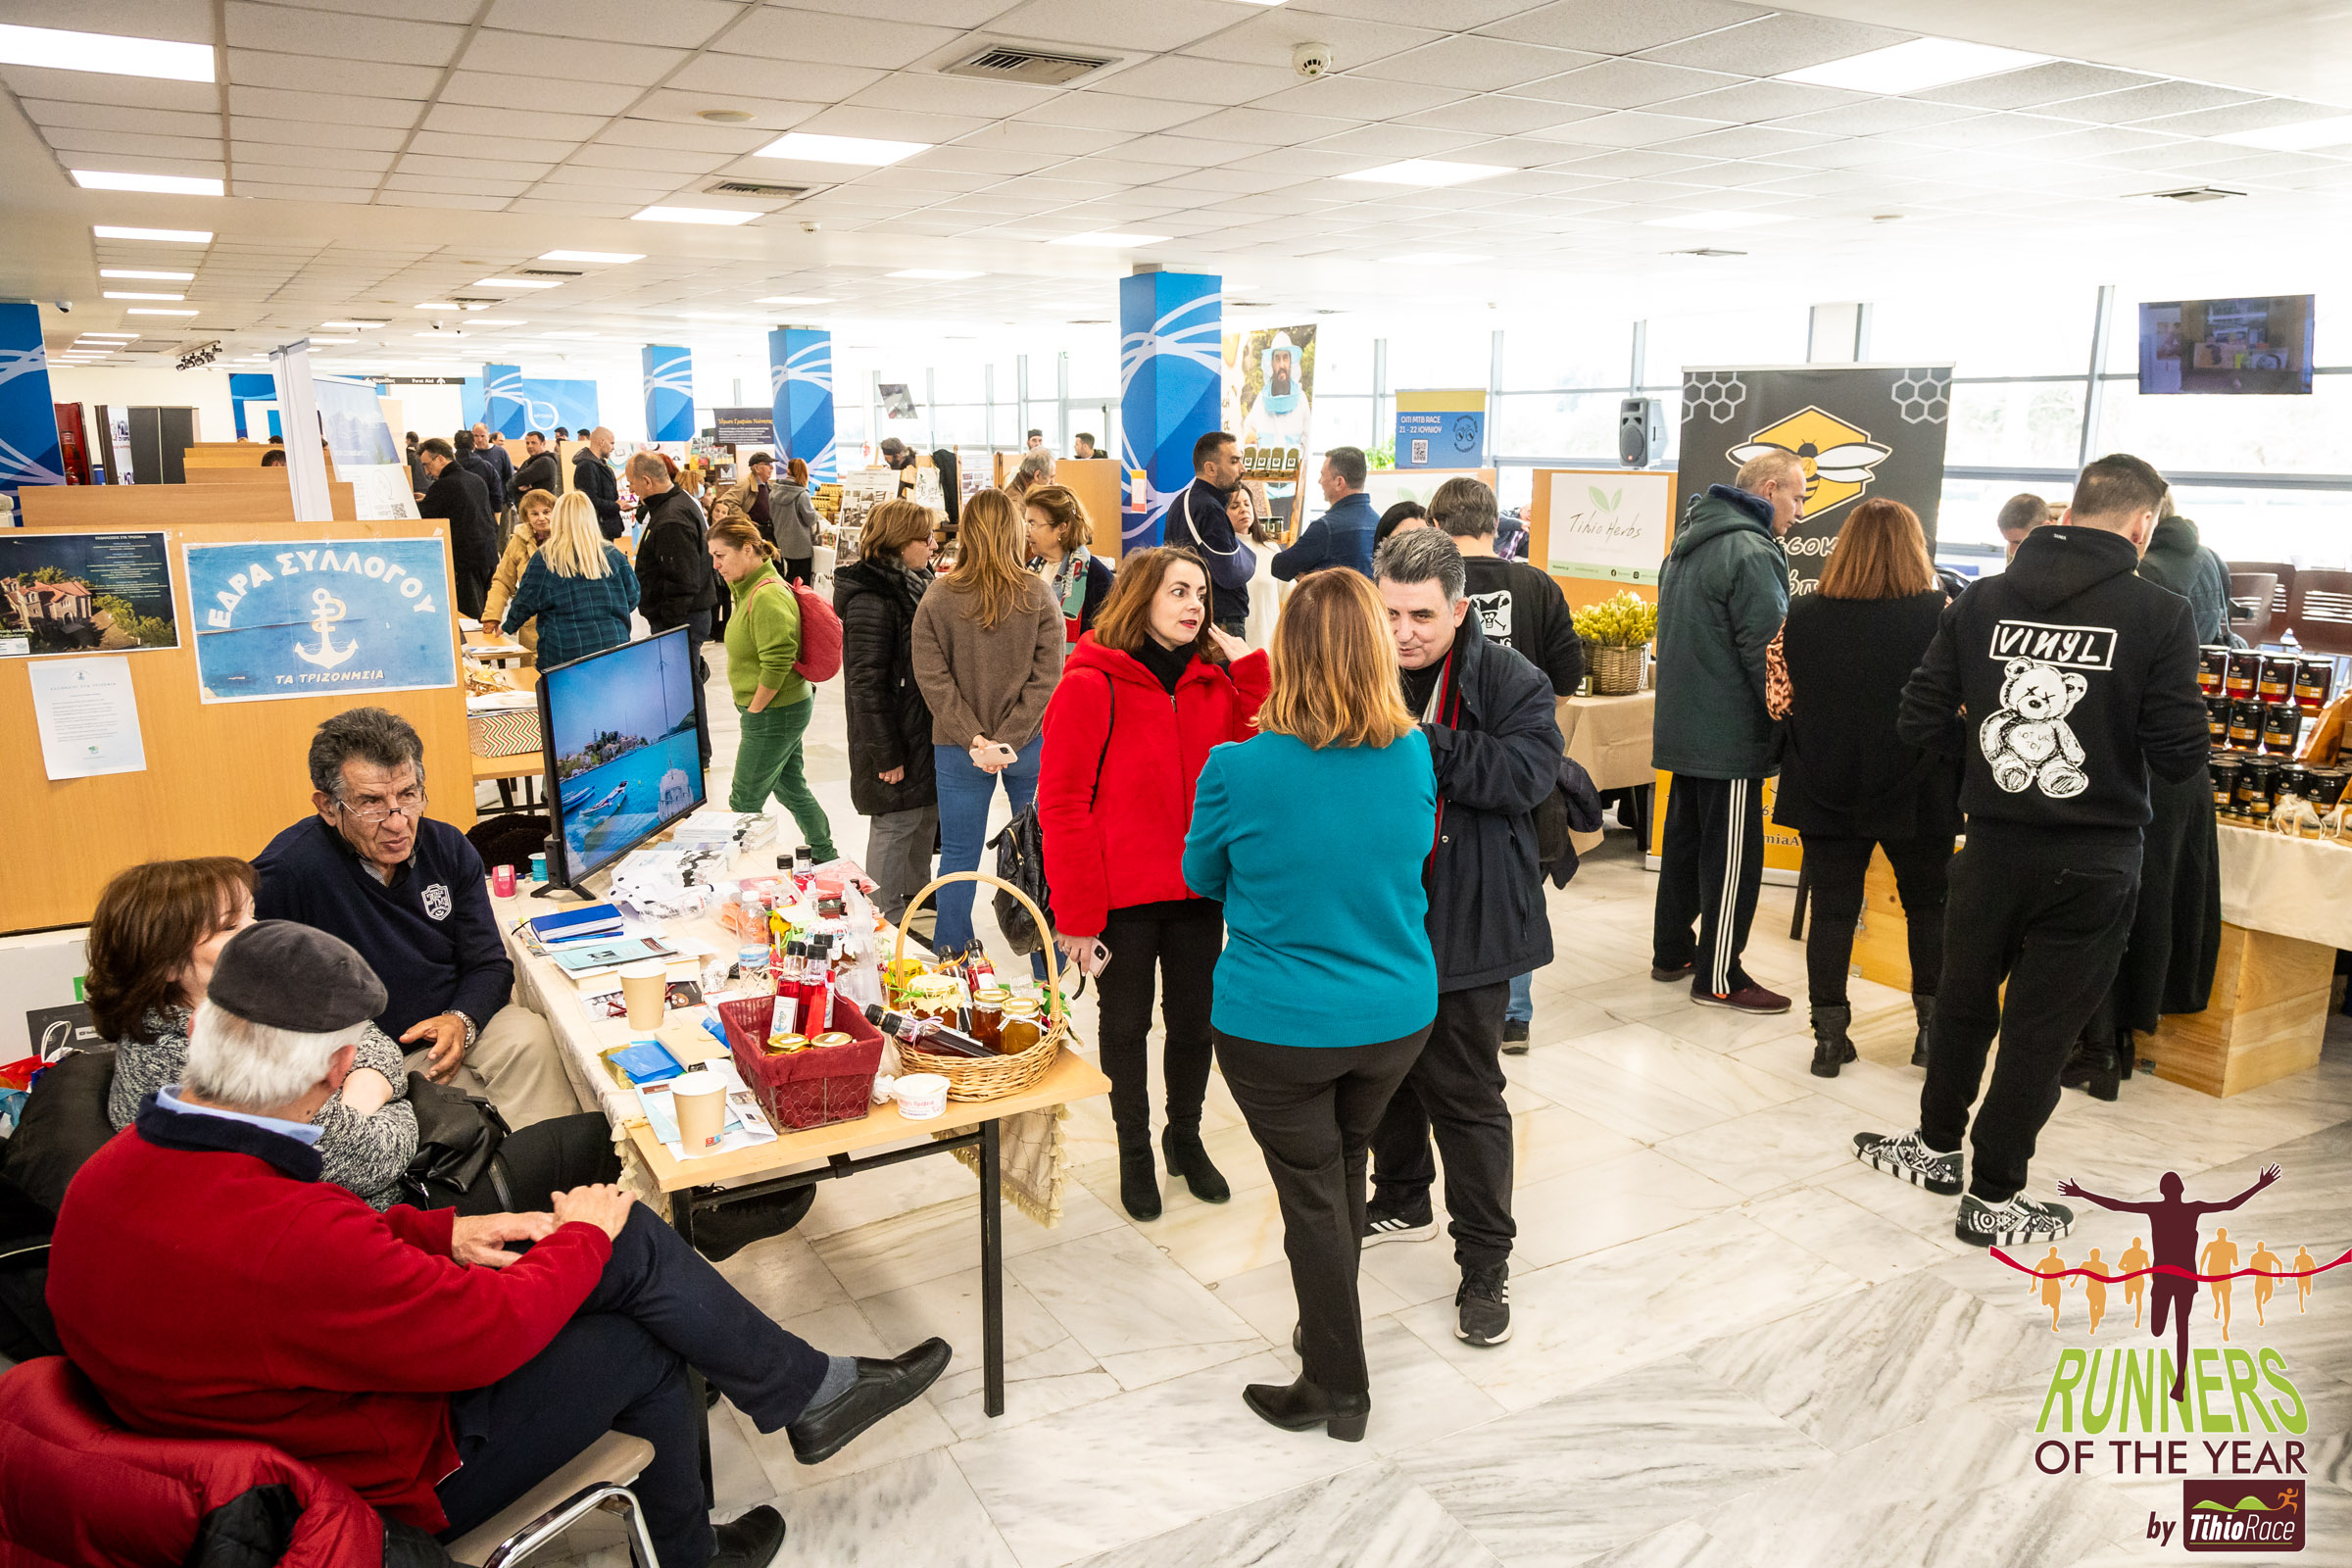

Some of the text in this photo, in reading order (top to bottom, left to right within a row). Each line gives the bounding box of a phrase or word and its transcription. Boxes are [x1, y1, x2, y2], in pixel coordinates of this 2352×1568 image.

[1570, 511, 1642, 543] Tihio Herbs
[208, 563, 274, 628] ΕΔΡΑ
[276, 550, 436, 613] ΣΥΛΛΟΓΟΥ
[1999, 626, 2101, 662] VINYL
[275, 674, 294, 685] ΤΑ
